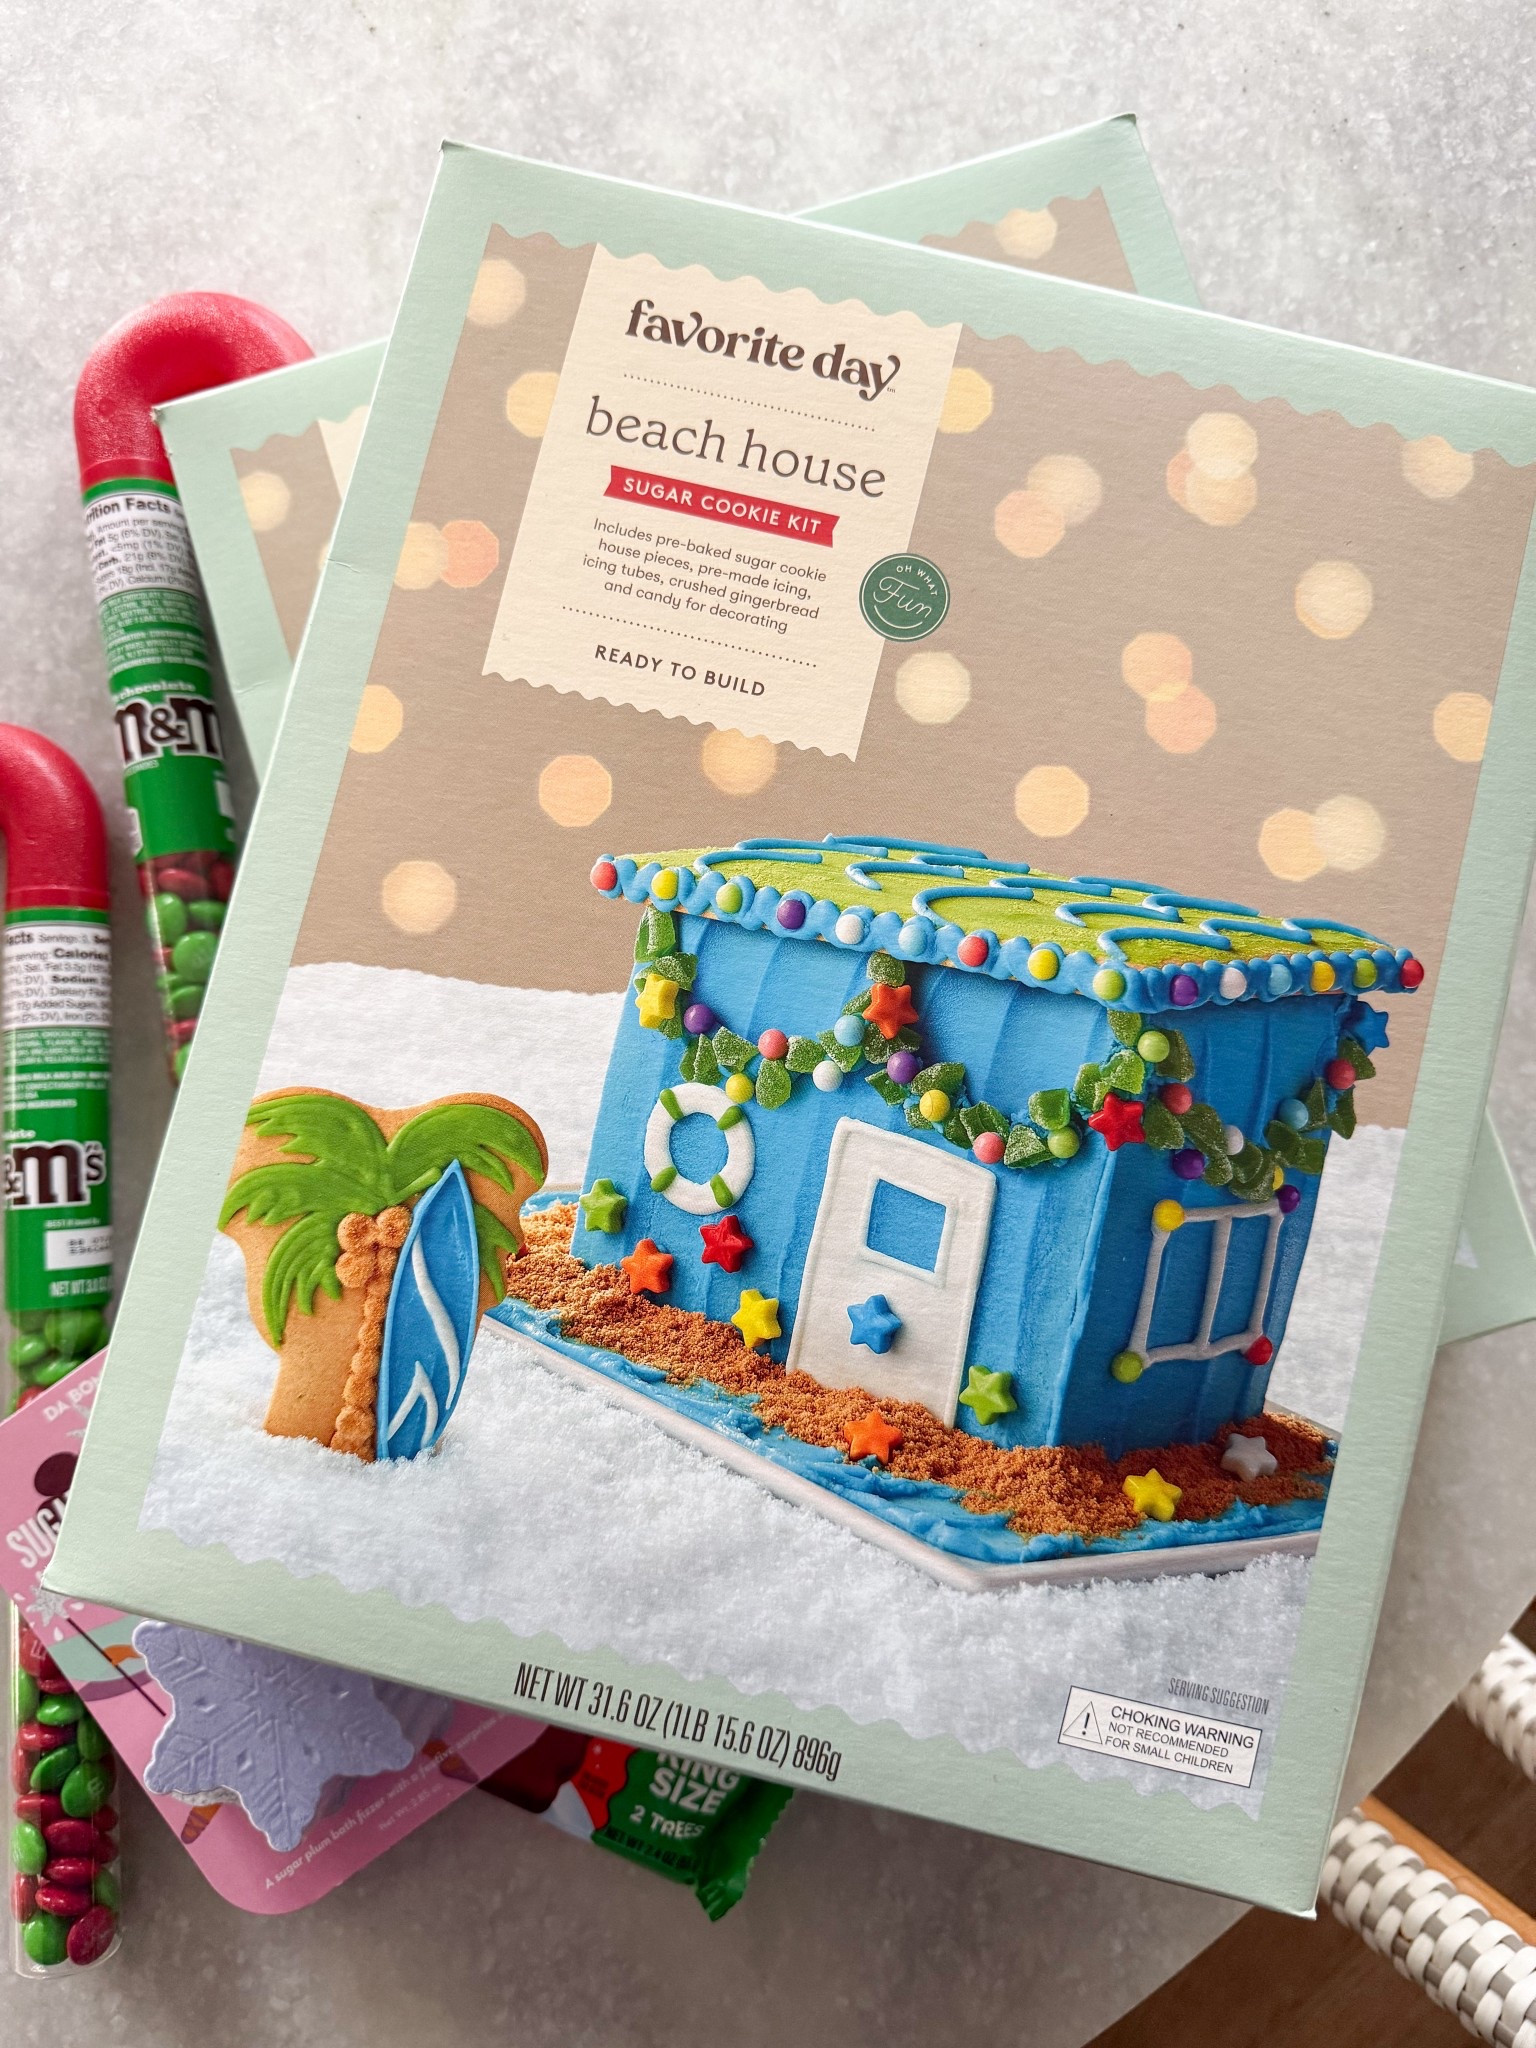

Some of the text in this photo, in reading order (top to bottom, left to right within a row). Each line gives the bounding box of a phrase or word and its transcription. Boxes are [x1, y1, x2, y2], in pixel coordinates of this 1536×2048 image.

[625, 299, 805, 371] favorite
[812, 344, 900, 401] day
[586, 395, 886, 498] beach house
[126, 498, 171, 514] Facts
[623, 478, 821, 535] SUGAR COOKIE KIT
[593, 518, 827, 581] Includes pre-baked sugar cookie
[598, 538, 811, 601] house pieces, pre-made icing,
[582, 553, 820, 619] icing tubes, crushed gingerbread
[873, 576, 932, 618] Fun
[896, 565, 938, 596] OH WHAT
[604, 581, 788, 635] and candy for decorating
[594, 645, 765, 697] READY TO BUILD
[43, 1400, 70, 1421] DA
[1168, 1677, 1270, 1715] SERVING SUGGESTION
[513, 1662, 842, 1782] NET WT 31.6 OZ (1LB 15.6 OZ) 896g
[1108, 1721, 1229, 1758] NOT RECOMMENDED
[1111, 1705, 1254, 1749] CHOKING WARNING
[1105, 1735, 1234, 1774] FOR SMALL CHILDREN
[649, 1767, 728, 1816] SIZE
[266, 1878, 275, 1890] A
[275, 1857, 303, 1881] sugar
[304, 1837, 332, 1863] plum
[330, 1817, 357, 1840] bath
[356, 1796, 385, 1825] fizzer
[386, 1778, 411, 1799] with
[629, 1804, 706, 1840] 2 TREES
